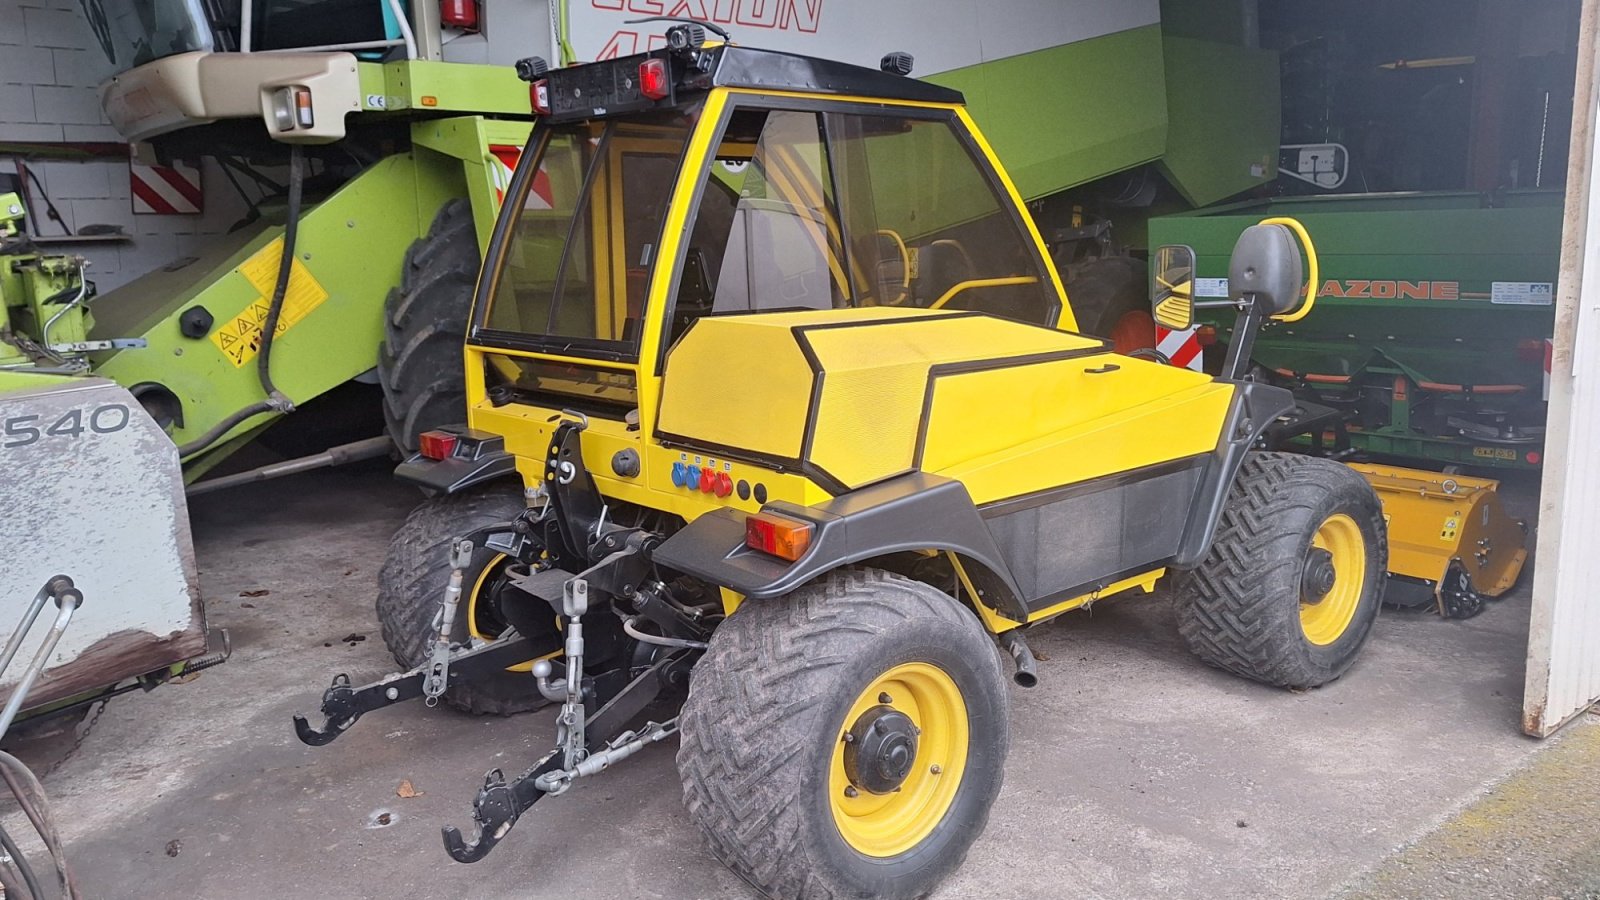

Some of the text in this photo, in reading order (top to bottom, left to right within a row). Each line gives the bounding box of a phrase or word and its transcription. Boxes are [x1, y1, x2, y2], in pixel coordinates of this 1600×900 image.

[592, 0, 822, 33] XION
[1301, 280, 1459, 300] AZONE
[4, 404, 130, 448] 540
